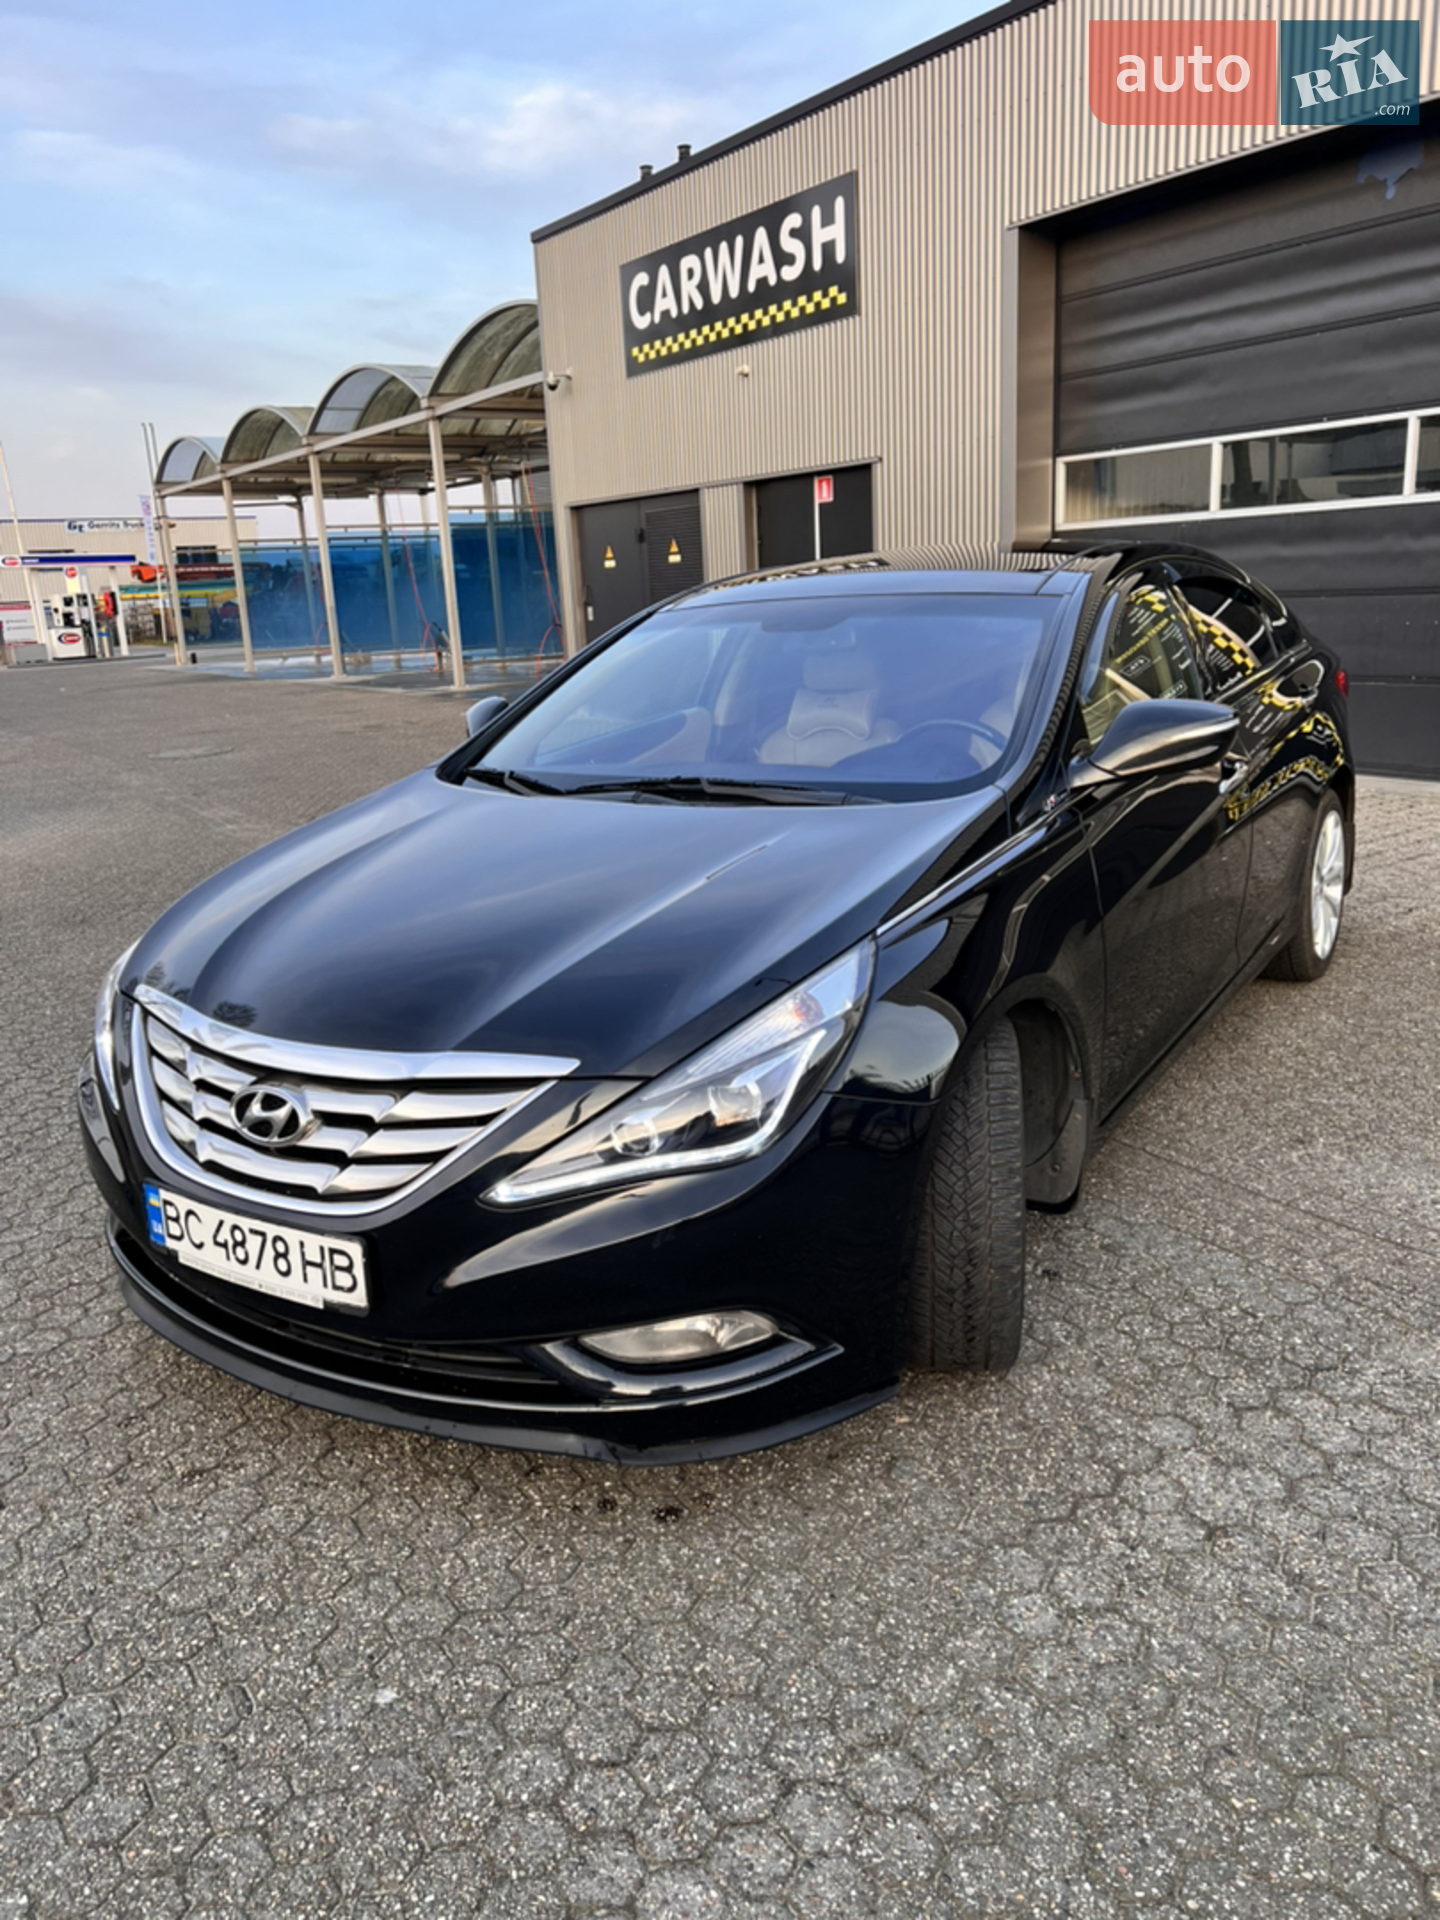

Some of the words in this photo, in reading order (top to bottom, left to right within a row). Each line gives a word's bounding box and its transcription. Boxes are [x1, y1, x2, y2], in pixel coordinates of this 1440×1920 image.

[629, 195, 846, 330] CARWASH
[162, 1198, 205, 1251] BC
[213, 1219, 292, 1278] 4878
[299, 1240, 358, 1294] HB
